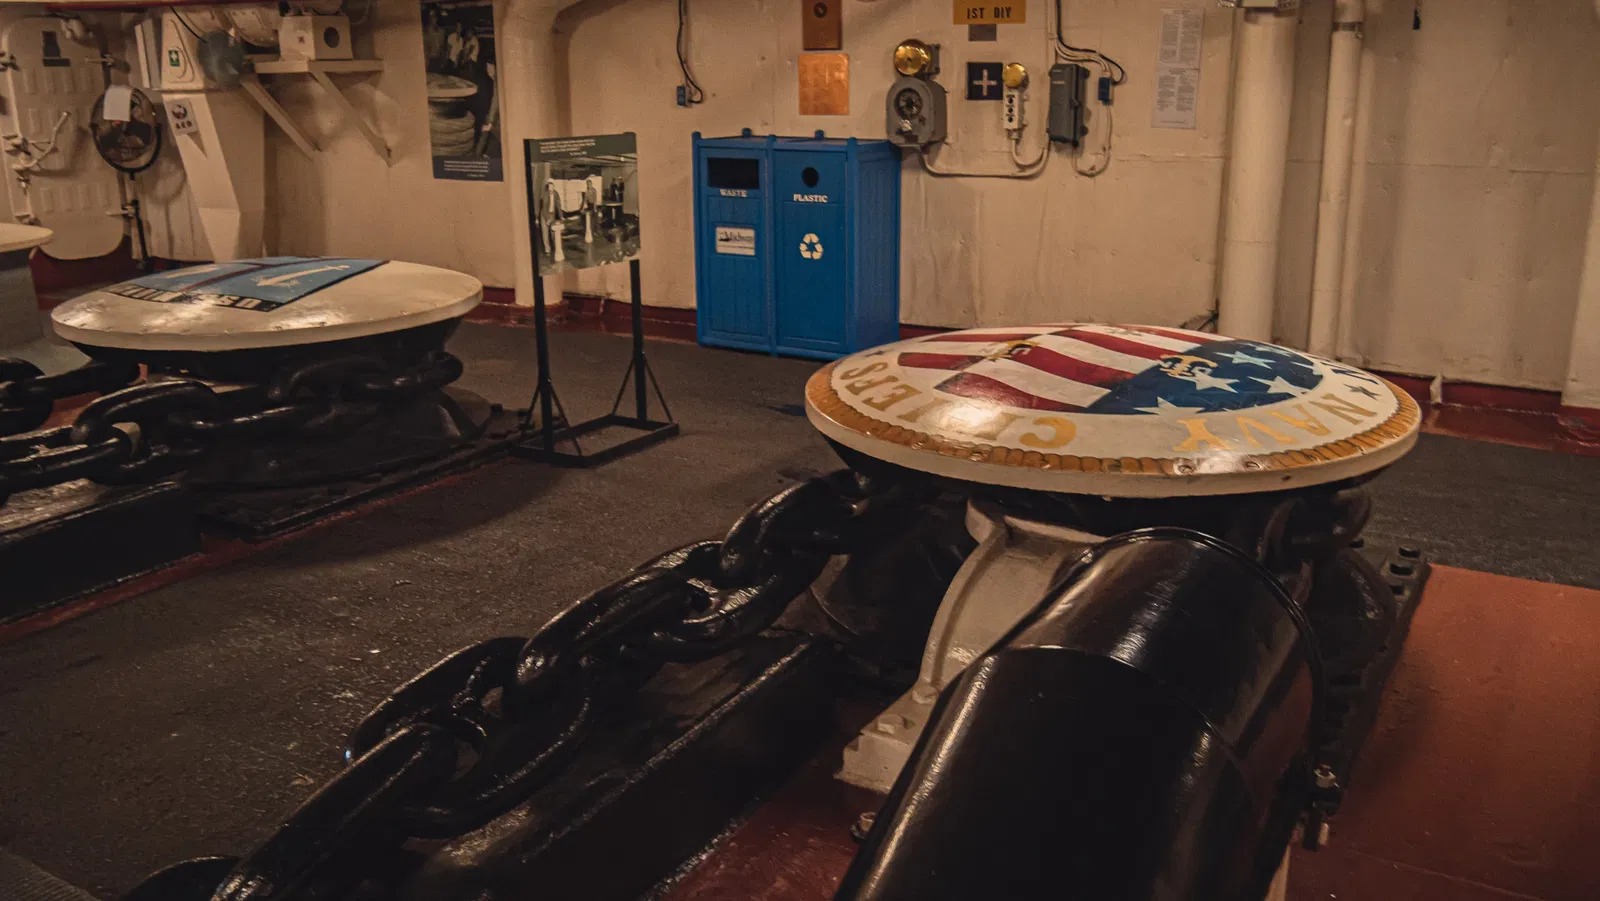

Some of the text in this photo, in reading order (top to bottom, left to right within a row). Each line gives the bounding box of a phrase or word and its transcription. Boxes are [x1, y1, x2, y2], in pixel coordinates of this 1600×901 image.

[720, 188, 748, 198] WASTE
[793, 193, 829, 203] PLASTIC
[1171, 393, 1378, 451] NAVY
